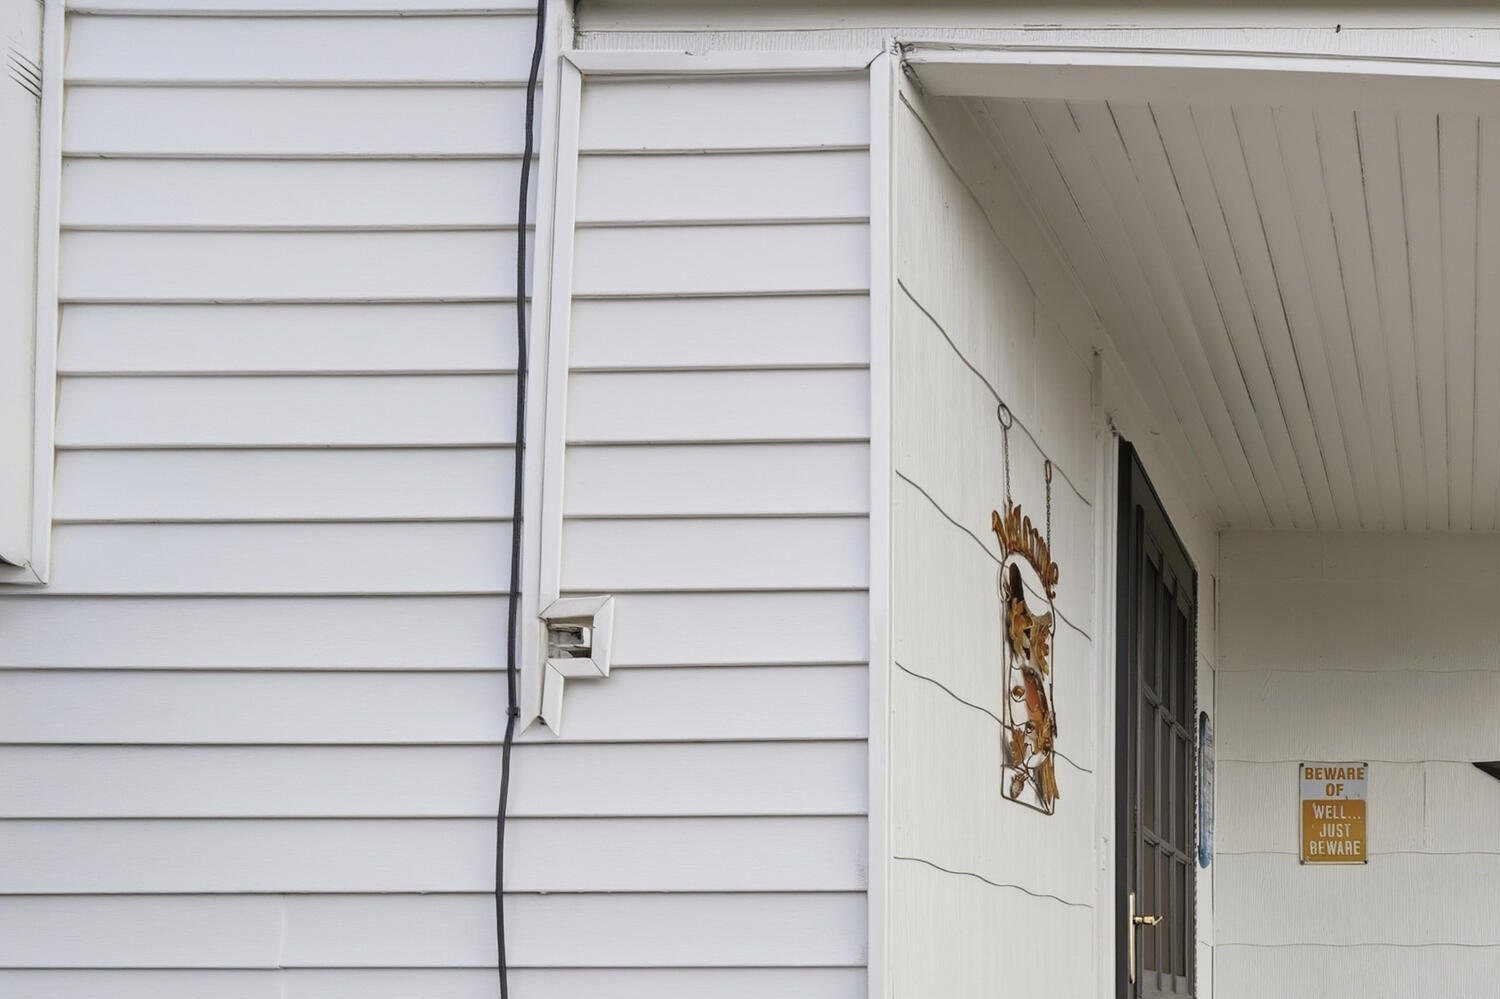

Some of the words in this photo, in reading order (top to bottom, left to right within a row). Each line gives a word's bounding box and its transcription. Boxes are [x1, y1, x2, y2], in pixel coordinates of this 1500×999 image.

[1305, 767, 1365, 780] BEWARE
[1326, 783, 1344, 796] OF
[1319, 823, 1352, 838] JUST
[1309, 840, 1361, 855] BEWARE
